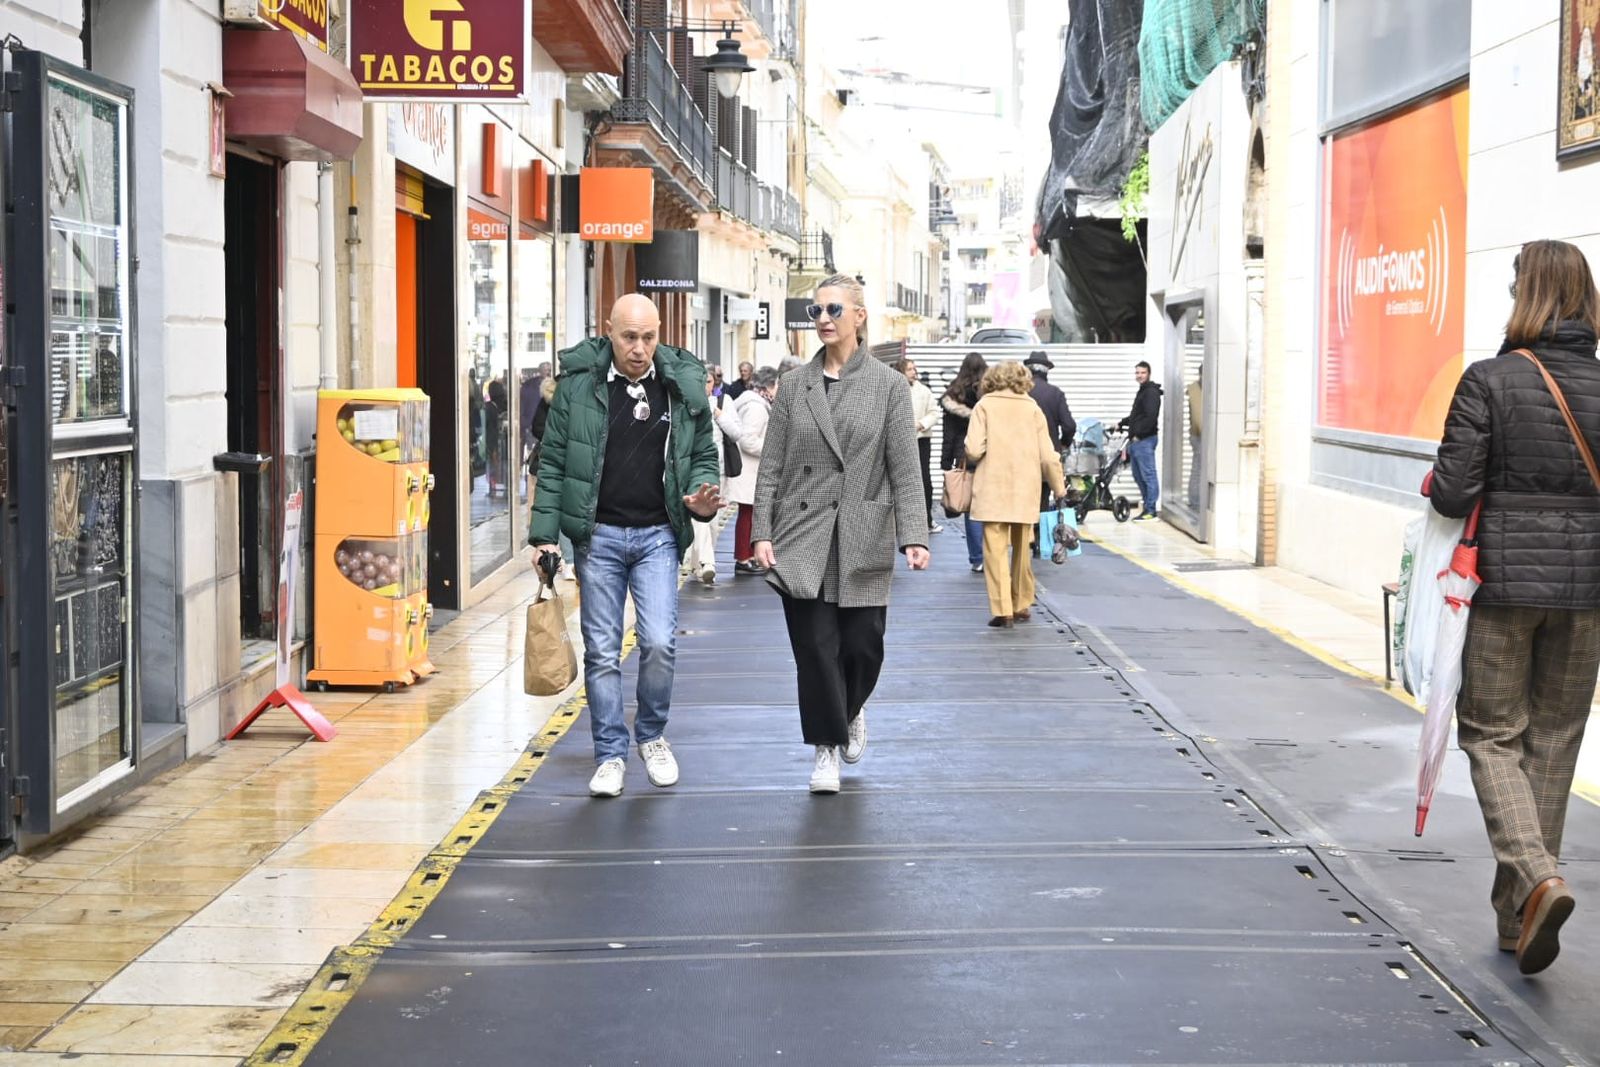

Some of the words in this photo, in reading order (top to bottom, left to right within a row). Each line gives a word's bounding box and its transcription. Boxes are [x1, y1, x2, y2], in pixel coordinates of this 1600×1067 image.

[360, 54, 514, 84] TABACOS
[583, 223, 644, 239] orange
[1355, 244, 1425, 295] AUDÍFONOS
[639, 279, 695, 288] CALZEDONIA
